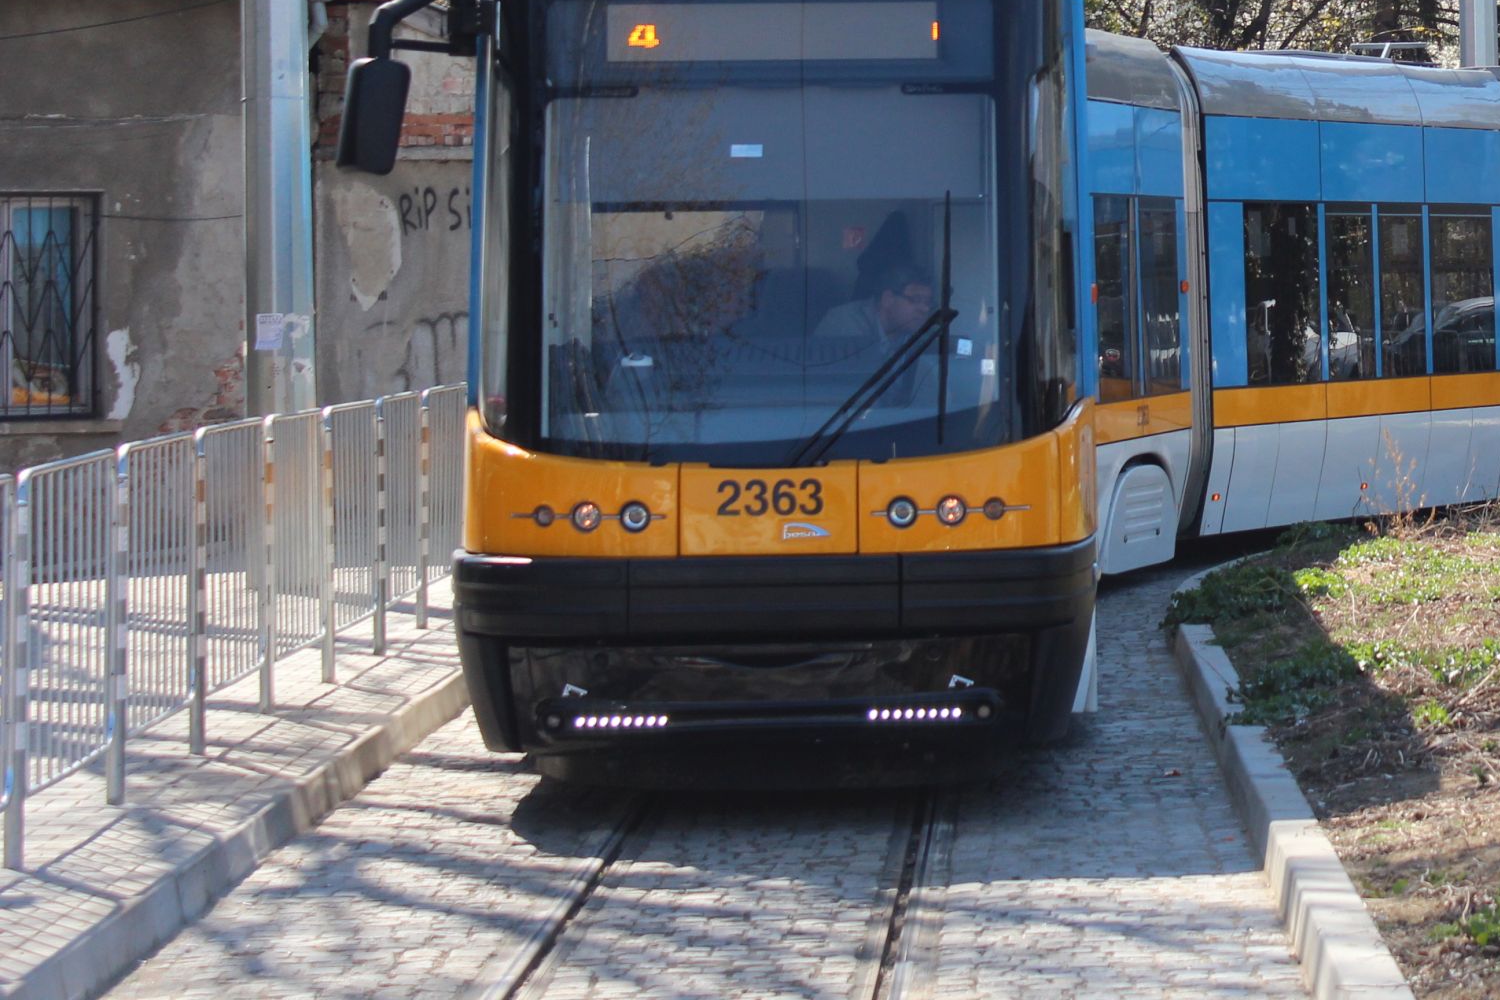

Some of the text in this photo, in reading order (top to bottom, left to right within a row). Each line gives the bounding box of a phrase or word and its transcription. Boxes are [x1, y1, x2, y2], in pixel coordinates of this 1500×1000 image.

[628, 24, 660, 48] 4
[717, 478, 824, 516] 2363
[783, 524, 822, 540] pesa
